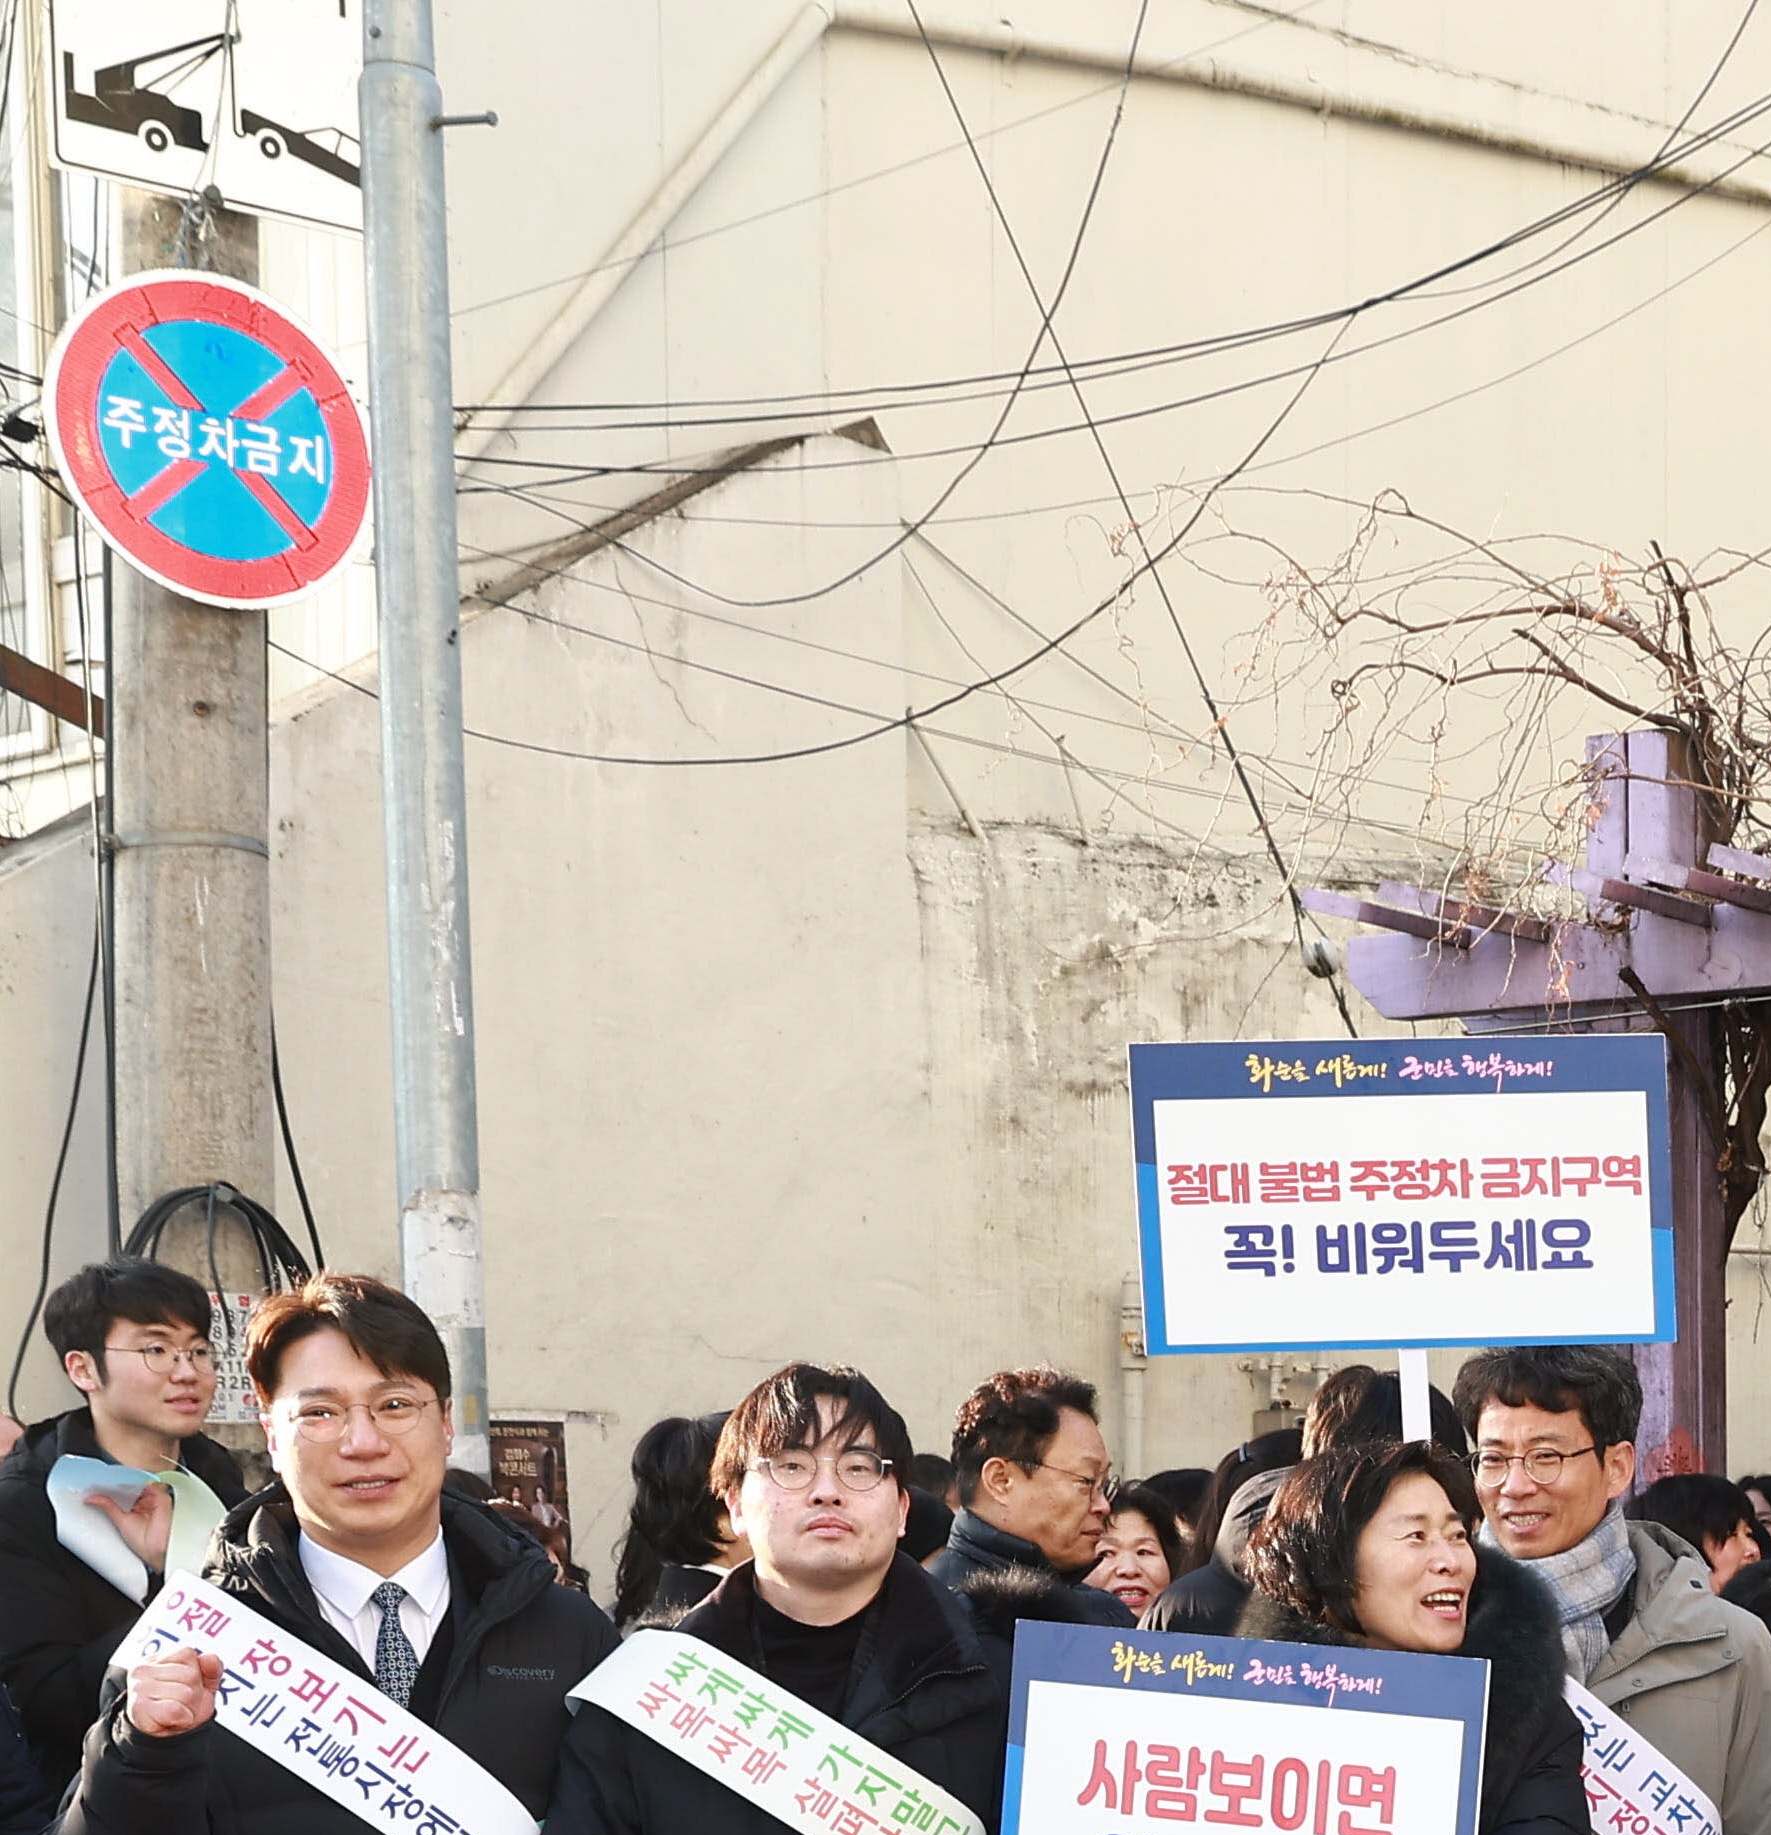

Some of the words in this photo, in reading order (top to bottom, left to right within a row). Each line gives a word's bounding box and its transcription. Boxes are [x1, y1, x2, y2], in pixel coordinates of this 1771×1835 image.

[103, 395, 327, 486] 주정차금지
[1167, 1163, 1251, 1205] 절대
[1259, 1161, 1340, 1203] 불법
[1349, 1158, 1474, 1201] 주정차
[1481, 1155, 1643, 1199] 금지구역
[1224, 1224, 1295, 1277] 꼭!
[1316, 1218, 1594, 1275] 비워두세요
[239, 1639, 431, 1774] 장보기는
[636, 1680, 788, 1785] 싸목싸목
[664, 1650, 815, 1751] 싸게싸게
